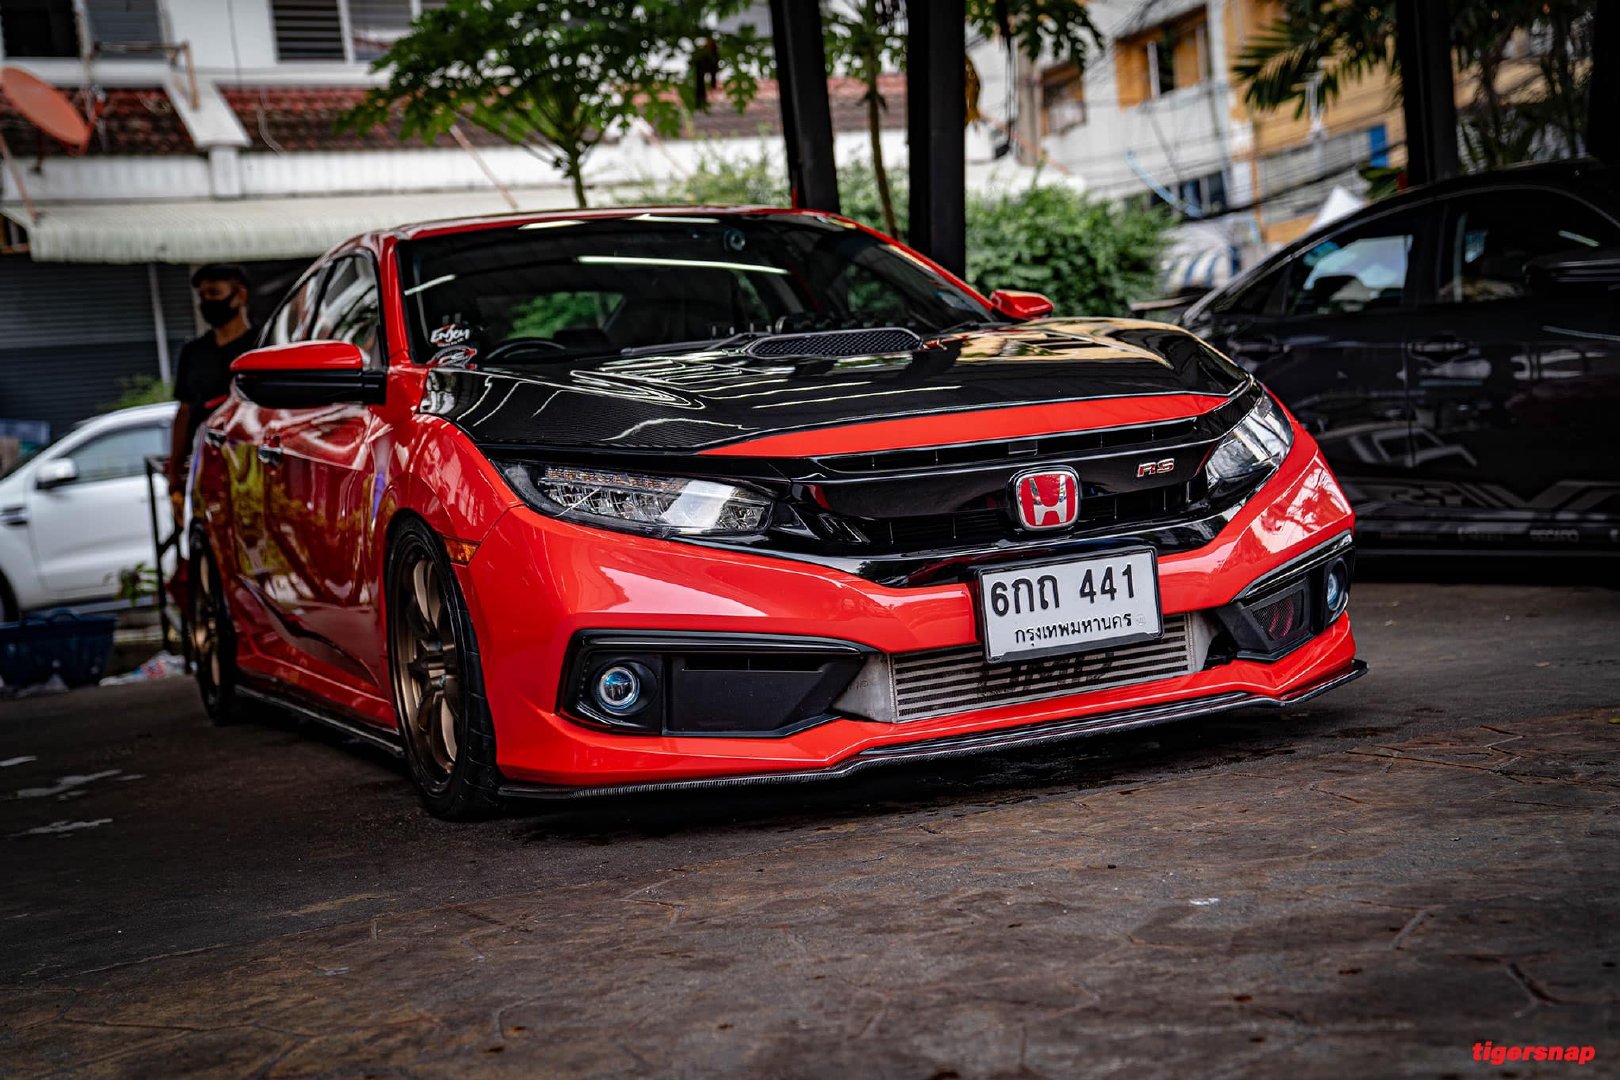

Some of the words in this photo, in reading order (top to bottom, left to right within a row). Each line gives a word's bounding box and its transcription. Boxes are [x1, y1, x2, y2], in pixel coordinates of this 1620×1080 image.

[1136, 458, 1175, 477] RS
[990, 575, 1060, 617] 6กถ
[1079, 563, 1135, 604] 441
[1015, 612, 1133, 647] กรุงเทพมหานคร
